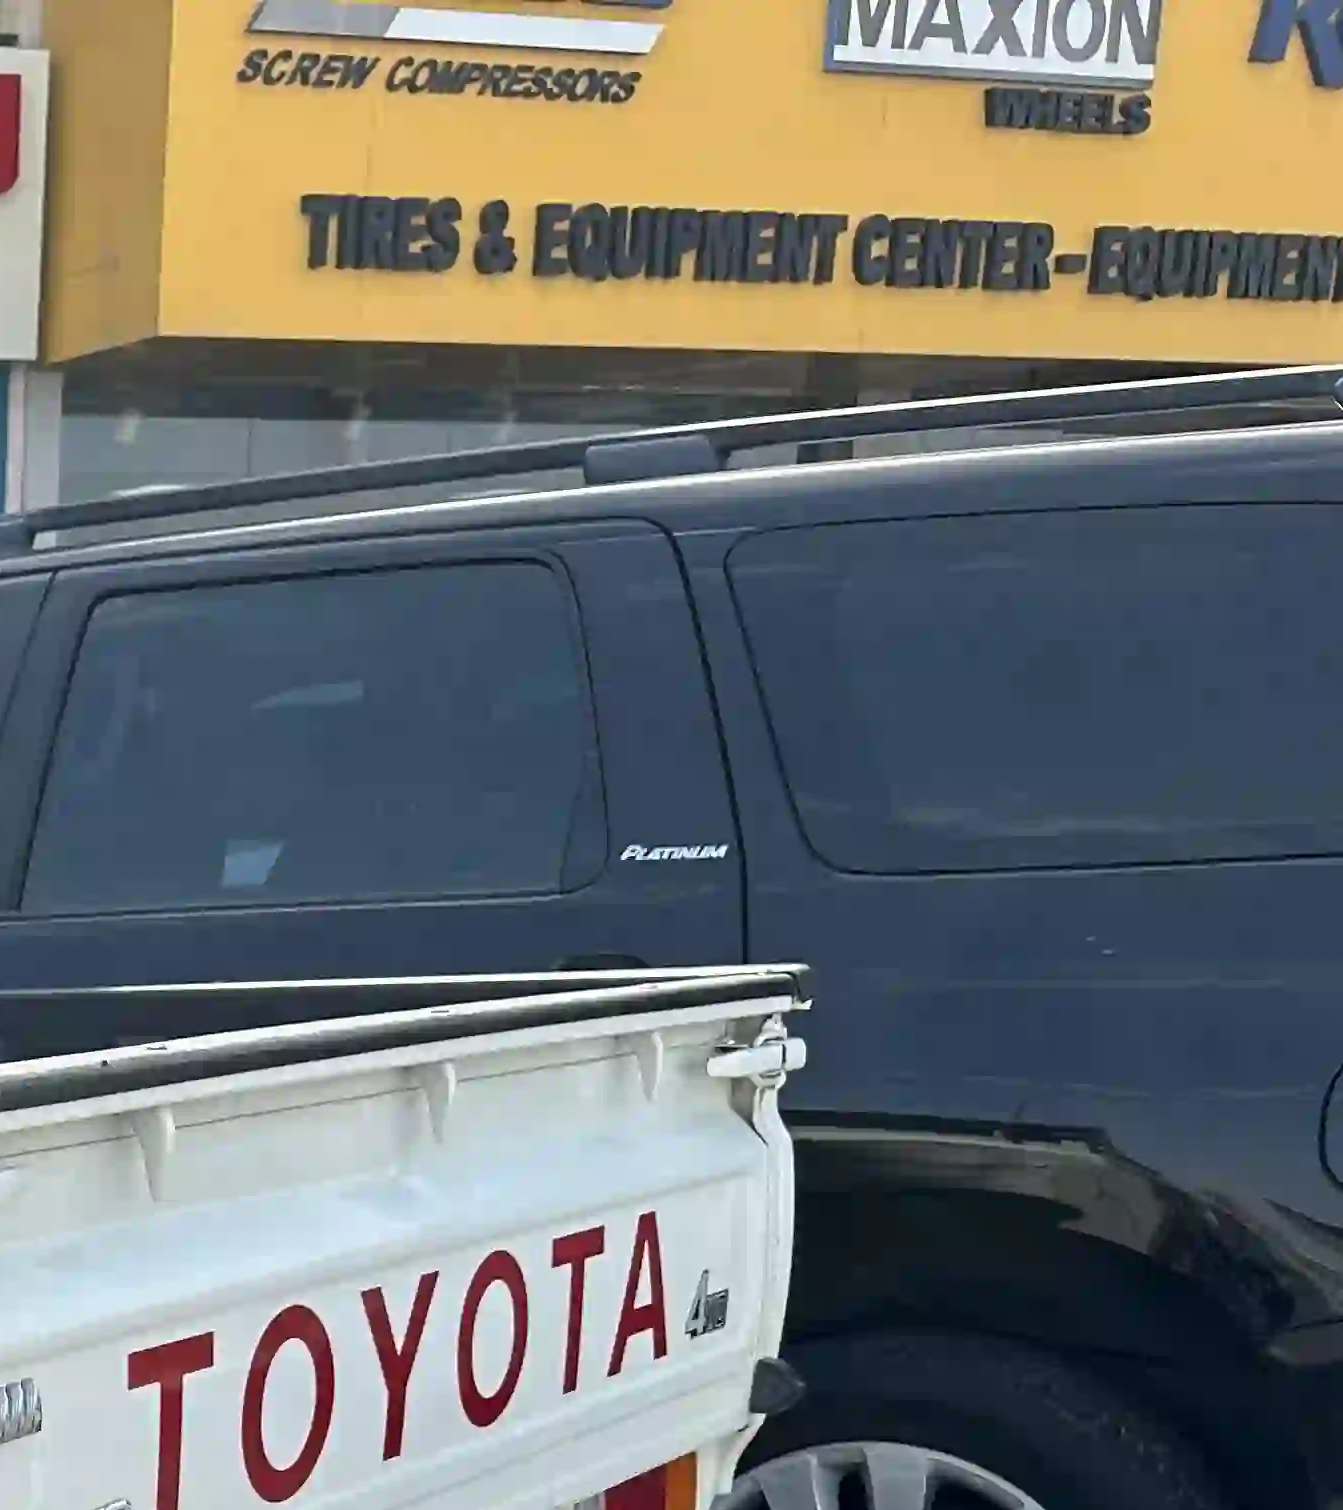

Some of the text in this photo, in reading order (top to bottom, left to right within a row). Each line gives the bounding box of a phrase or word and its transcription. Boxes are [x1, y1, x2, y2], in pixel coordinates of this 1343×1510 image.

[835, 0, 1159, 64] MAXION
[237, 49, 642, 103] SCREW COMPRESSORS
[984, 86, 1152, 134] WHEELS
[300, 193, 462, 271] TIRES
[475, 199, 518, 275] &
[533, 202, 849, 285] EQUIPMENT
[621, 845, 729, 861] PLATINUM
